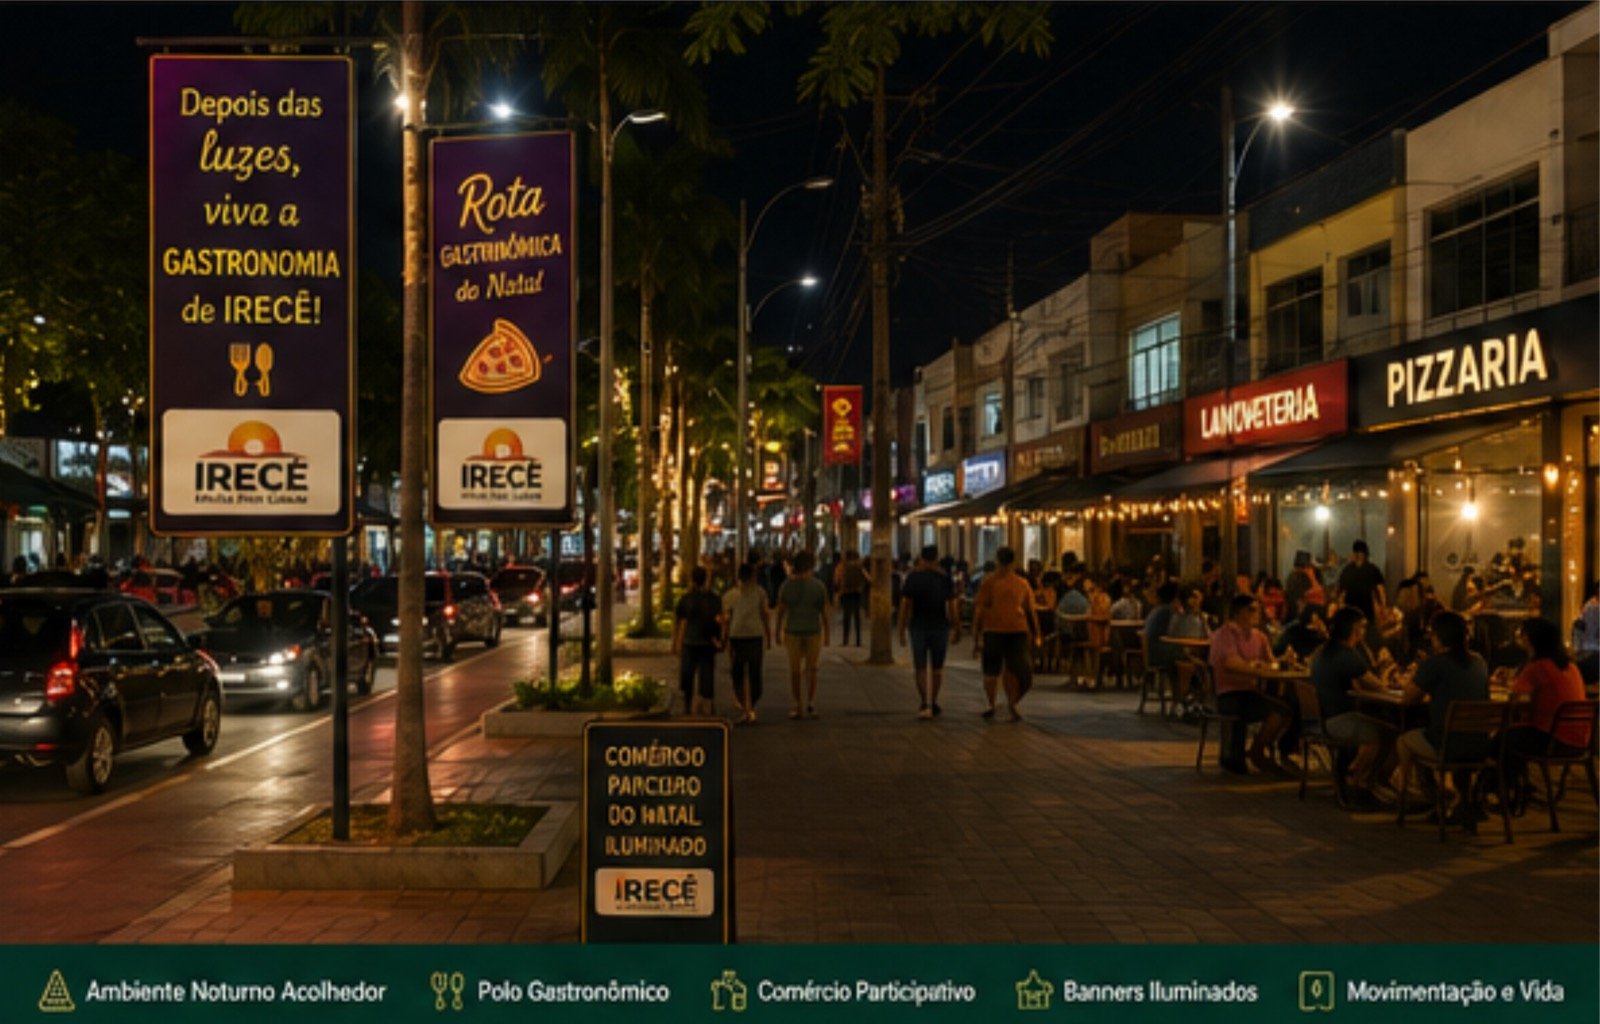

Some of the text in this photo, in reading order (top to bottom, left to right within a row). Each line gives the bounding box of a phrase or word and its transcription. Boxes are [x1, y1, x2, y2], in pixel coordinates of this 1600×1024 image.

[180, 86, 323, 125] Depois das
[199, 128, 301, 182] luzes,
[203, 193, 299, 227] viva a
[456, 172, 547, 236] Rota
[162, 246, 341, 278] GASTRONOMIA
[181, 288, 322, 324] de IRECÊ!
[1387, 328, 1549, 411] PIZZARIA
